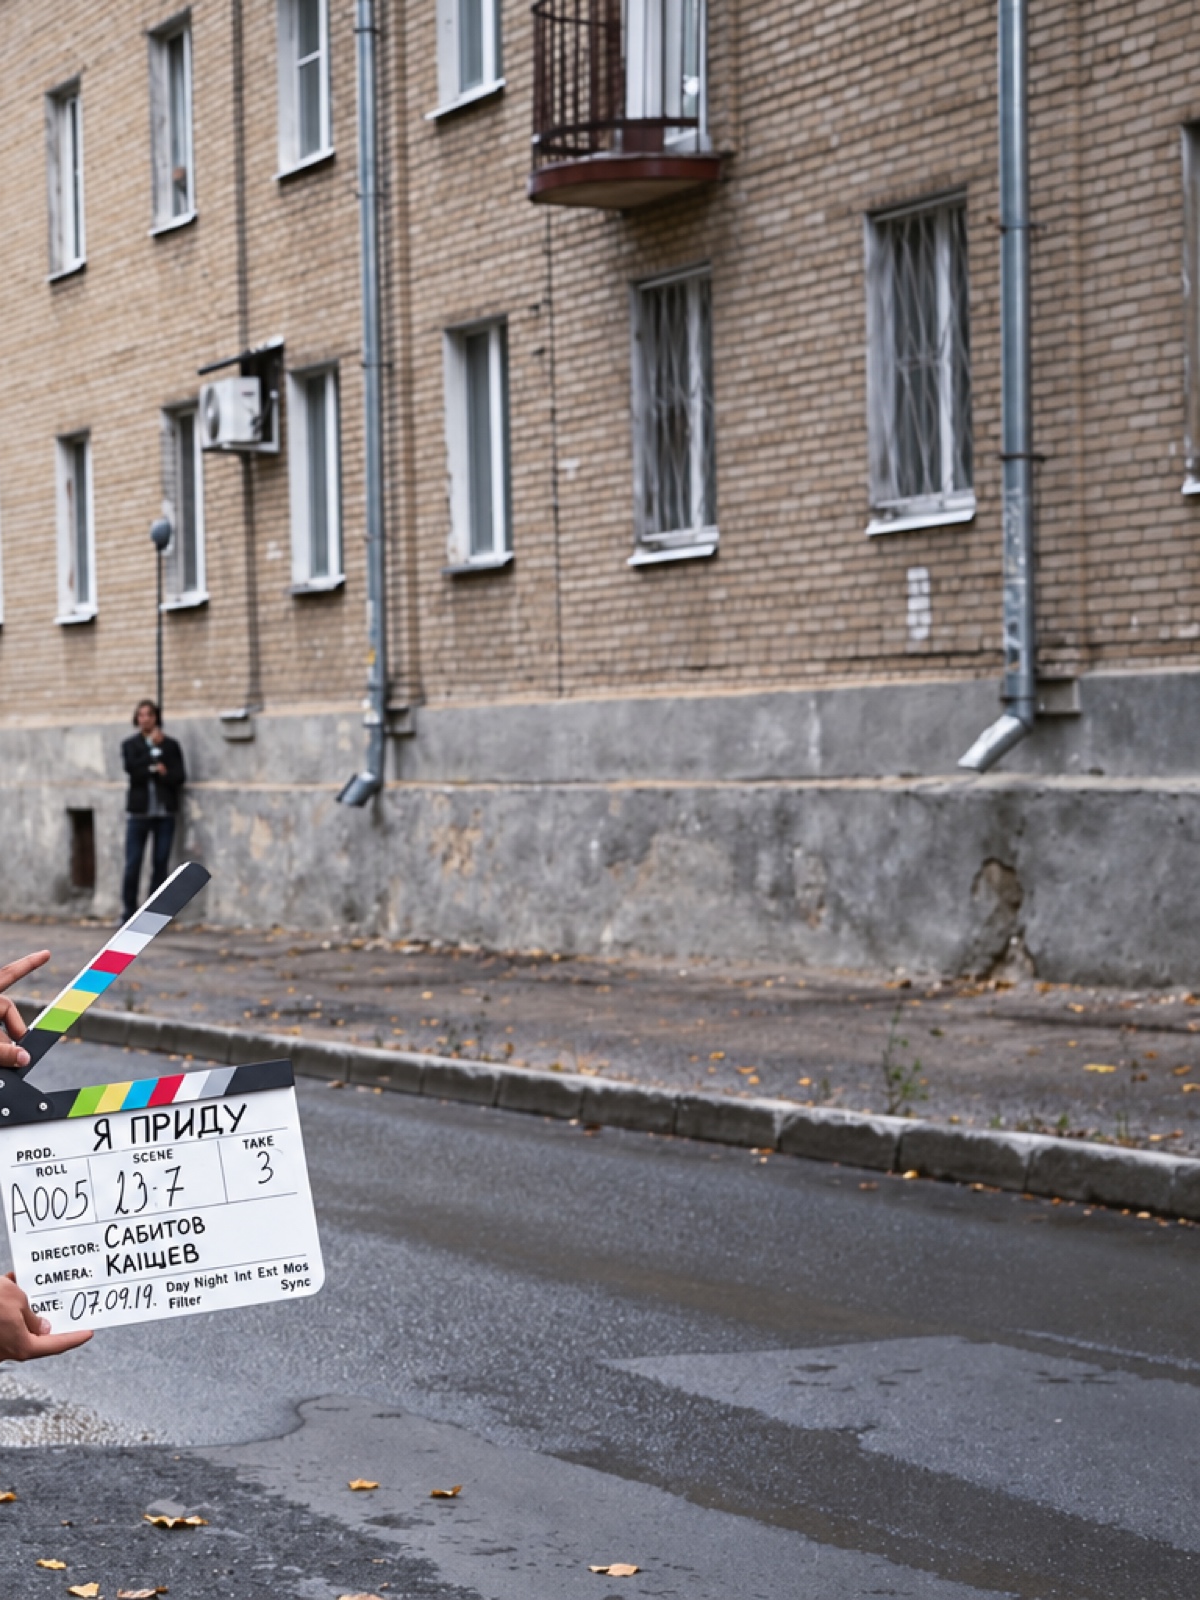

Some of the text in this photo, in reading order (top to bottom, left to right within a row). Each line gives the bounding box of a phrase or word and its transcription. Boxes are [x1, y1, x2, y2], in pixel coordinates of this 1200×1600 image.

[93, 1103, 247, 1152] Я ПРИДУ
[242, 1135, 275, 1150] TAKE
[16, 1147, 56, 1162] PROD.
[133, 1149, 174, 1164] SCENE
[36, 1164, 68, 1177] ROLL
[257, 1150, 275, 1185] 3
[11, 1179, 89, 1233] A005
[104, 1216, 206, 1249] САБИТОВ
[31, 1242, 100, 1262] DIRECTOR:
[35, 1267, 93, 1286] CAMERA:
[166, 1262, 310, 1294] Day Night Int Ext Mos
[281, 1277, 312, 1292] Sync
[169, 1295, 202, 1310] Filter
